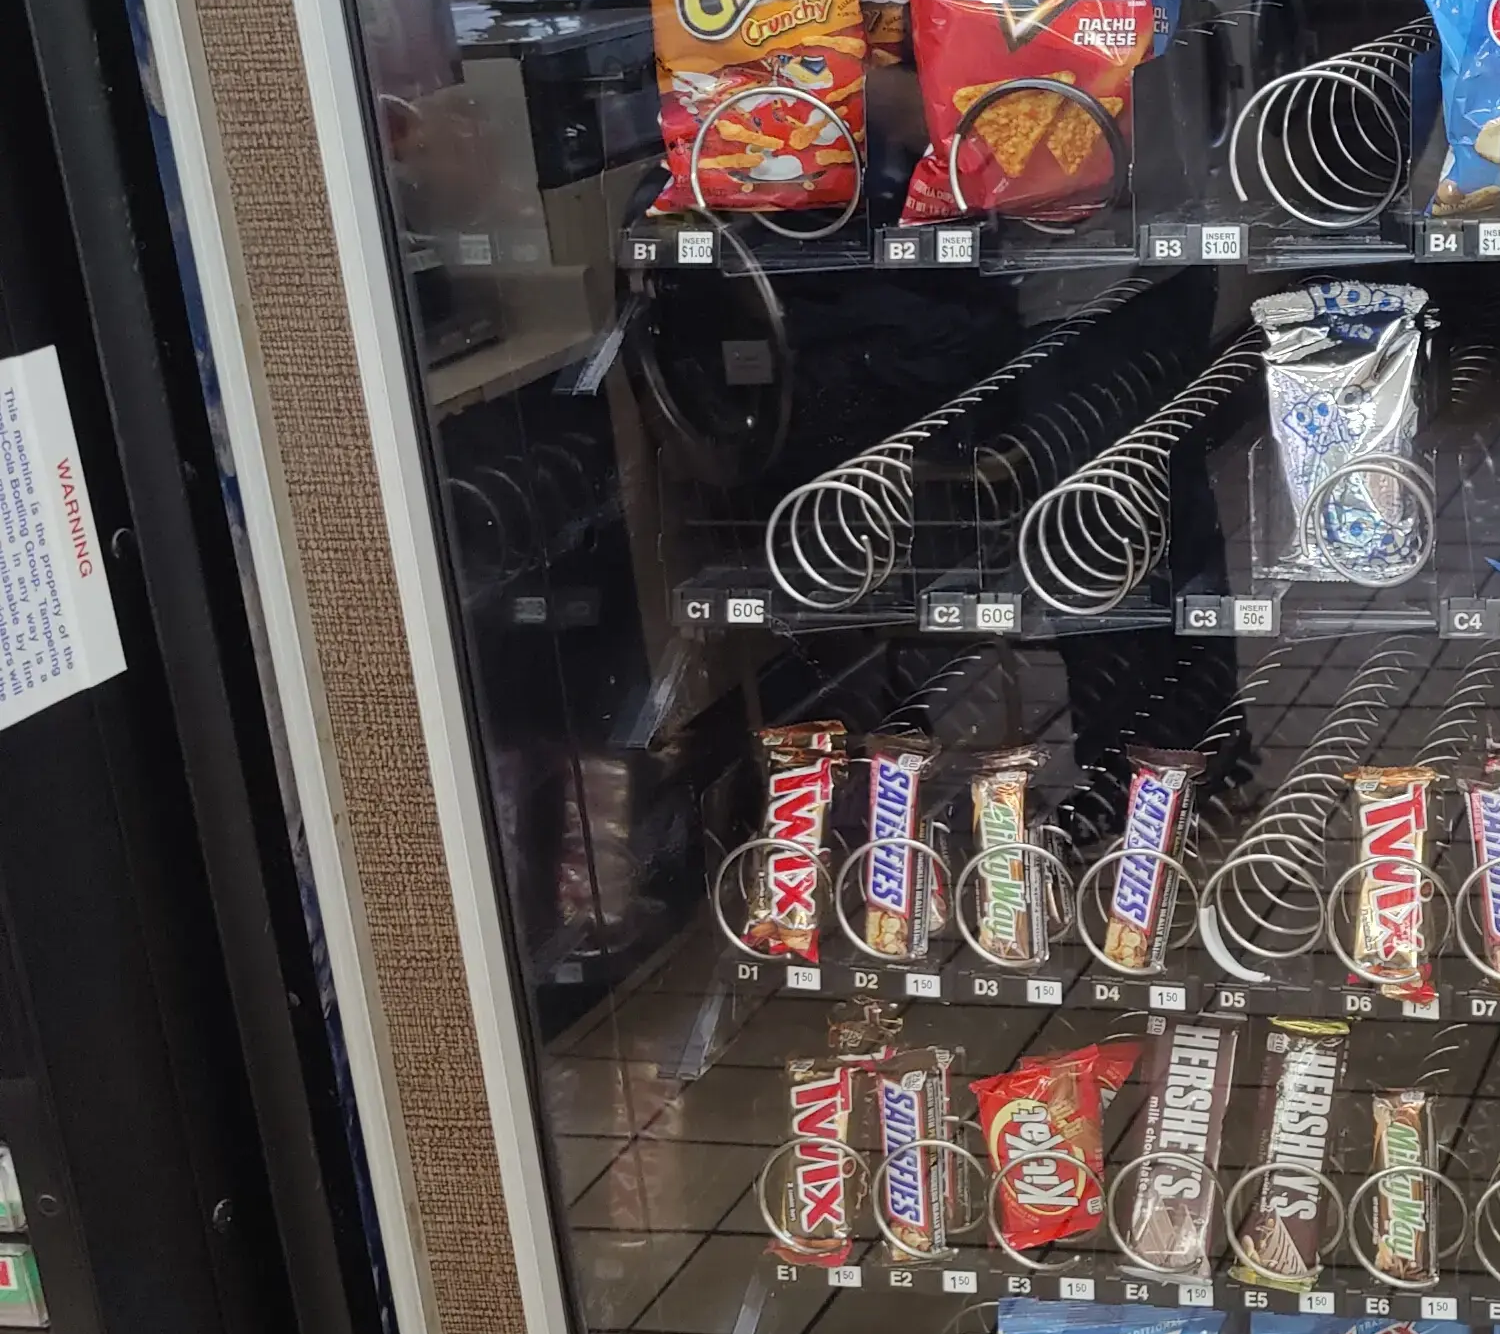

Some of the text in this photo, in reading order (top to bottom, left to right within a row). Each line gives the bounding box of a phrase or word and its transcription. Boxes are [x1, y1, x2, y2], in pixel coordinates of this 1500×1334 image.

[1078, 17, 1136, 31] NACHO
[1074, 31, 1136, 46] CHEESE
[633, 243, 657, 260] B1
[681, 244, 713, 258] $1.00
[889, 243, 917, 260] B2
[1155, 239, 1182, 257] B3
[1204, 240, 1237, 255] $1.00
[1429, 234, 1458, 252] B4
[4, 387, 18, 422] This
[14, 430, 34, 495] machine
[57, 457, 93, 578] WARNING
[35, 522, 46, 547] the
[10, 478, 29, 537] Bottling
[38, 598, 61, 677] Tampering
[40, 553, 62, 617] property
[17, 576, 39, 642] any way
[687, 602, 710, 618] C1
[934, 606, 960, 623] C2
[1190, 609, 1217, 627] C3
[1454, 612, 1482, 630] C4
[63, 646, 74, 670] the
[22, 660, 34, 689] fine
[738, 965, 759, 981] D1
[855, 973, 878, 990] D2
[975, 979, 998, 997] D3
[1096, 985, 1121, 1001] D4
[1221, 991, 1245, 1007] D5
[1346, 995, 1372, 1011] D6
[1472, 1001, 1497, 1017] D7
[1153, 1024, 1221, 1201] HERSHEY'S
[777, 1266, 797, 1282] E1
[890, 1271, 912, 1287] E2
[1008, 1277, 1032, 1293] E3
[1126, 1284, 1149, 1300] E4
[1245, 1292, 1268, 1308] E5
[1366, 1298, 1390, 1315] E6
